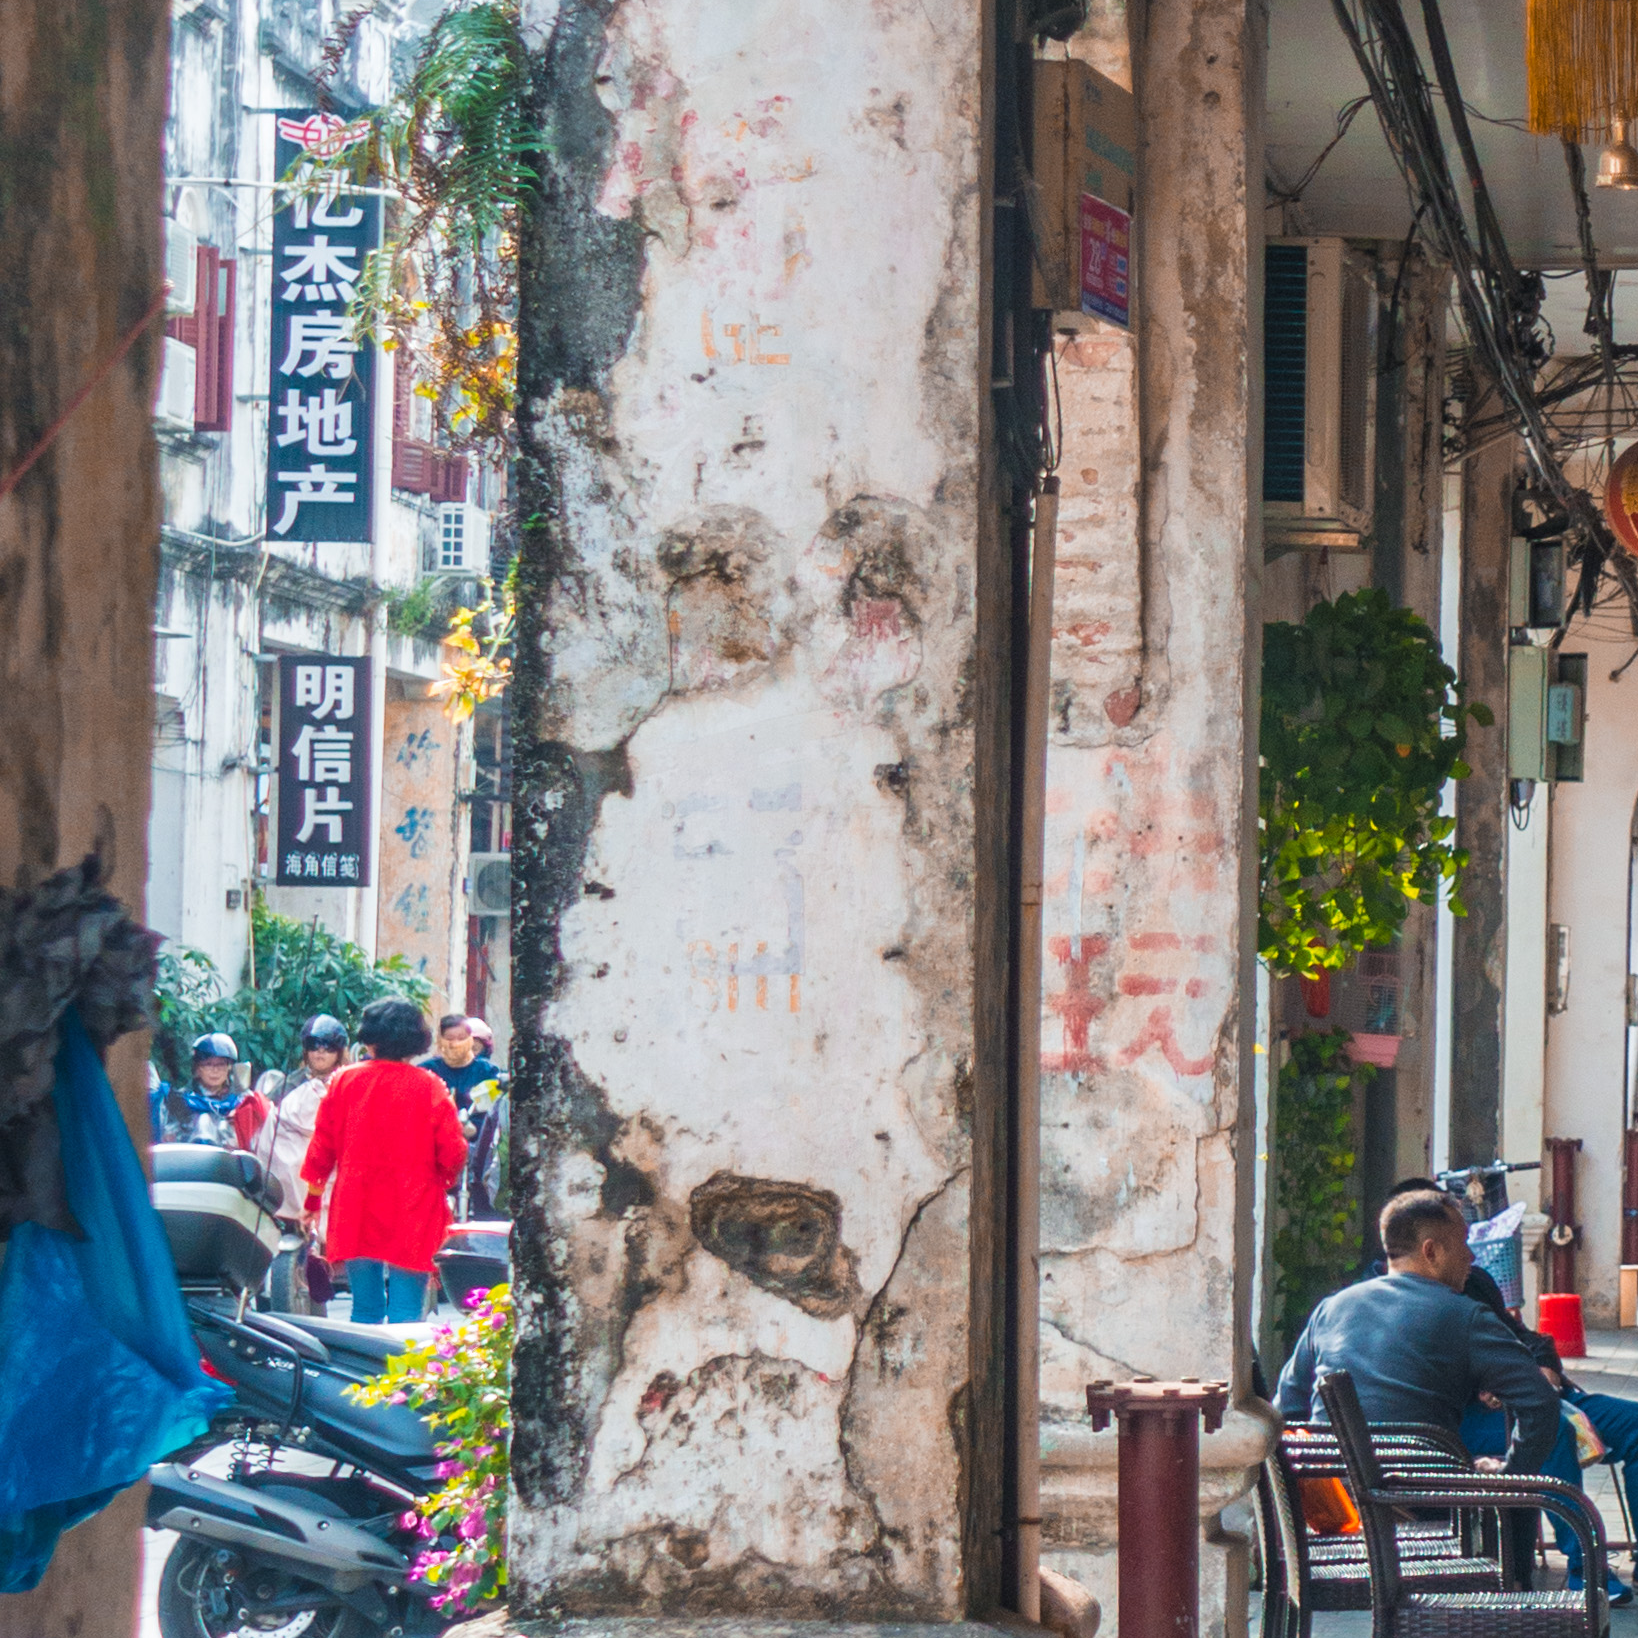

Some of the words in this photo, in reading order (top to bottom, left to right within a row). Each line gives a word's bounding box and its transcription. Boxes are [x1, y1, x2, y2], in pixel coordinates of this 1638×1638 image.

[273, 162, 364, 536] 亿杰房地产
[291, 665, 355, 844] 明信片
